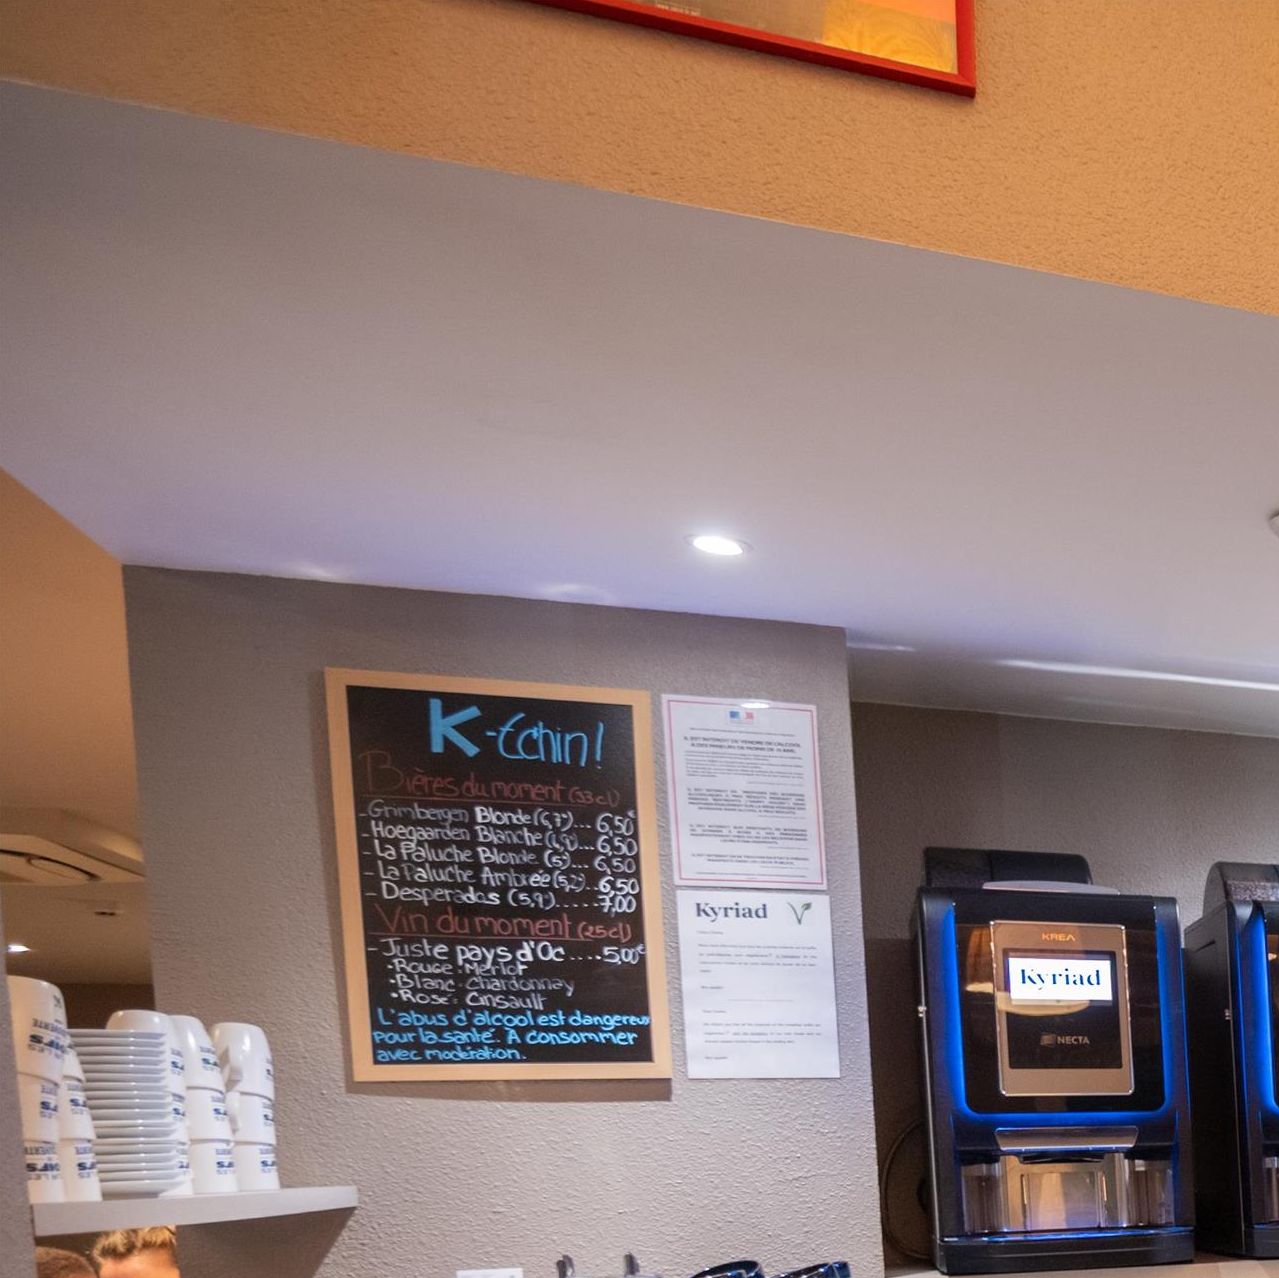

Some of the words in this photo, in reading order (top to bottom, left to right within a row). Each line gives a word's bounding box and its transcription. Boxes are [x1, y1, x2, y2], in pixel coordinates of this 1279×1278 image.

[359, 749, 458, 798] Bières
[461, 771, 489, 799] du
[491, 778, 567, 803] moment
[367, 799, 469, 827] Grimbergen
[474, 805, 532, 825] Blonde
[370, 819, 471, 845] Hoegaarden
[475, 824, 544, 846] Blanche
[373, 838, 398, 861] La
[400, 840, 475, 863] Paluche
[476, 846, 540, 865] Blonde
[377, 859, 401, 881] La
[400, 861, 477, 884] Paluche
[480, 865, 552, 888] Ambrée
[381, 880, 501, 907] Desperados
[373, 902, 429, 934] Vin
[435, 905, 471, 934] du
[473, 911, 572, 940] moment
[696, 901, 769, 923] Kyriad
[1041, 932, 1076, 942] KREA
[379, 936, 450, 961] Juste
[455, 944, 513, 970] pays
[464, 960, 529, 976] Merlot
[1020, 967, 1102, 991] Kyriad
[395, 973, 457, 992] Blanc
[465, 974, 575, 997] Chardonnay
[465, 991, 547, 1011] Cinsault
[376, 1006, 450, 1027] L'abus
[452, 1007, 535, 1028] d'alcool
[537, 1009, 567, 1028] est
[568, 1009, 652, 1032] dangereux
[372, 1030, 417, 1045] pour
[418, 1026, 440, 1045] la
[524, 1029, 639, 1046] consommer
[1057, 1035, 1090, 1045] NECTA
[376, 1048, 423, 1063] avec
